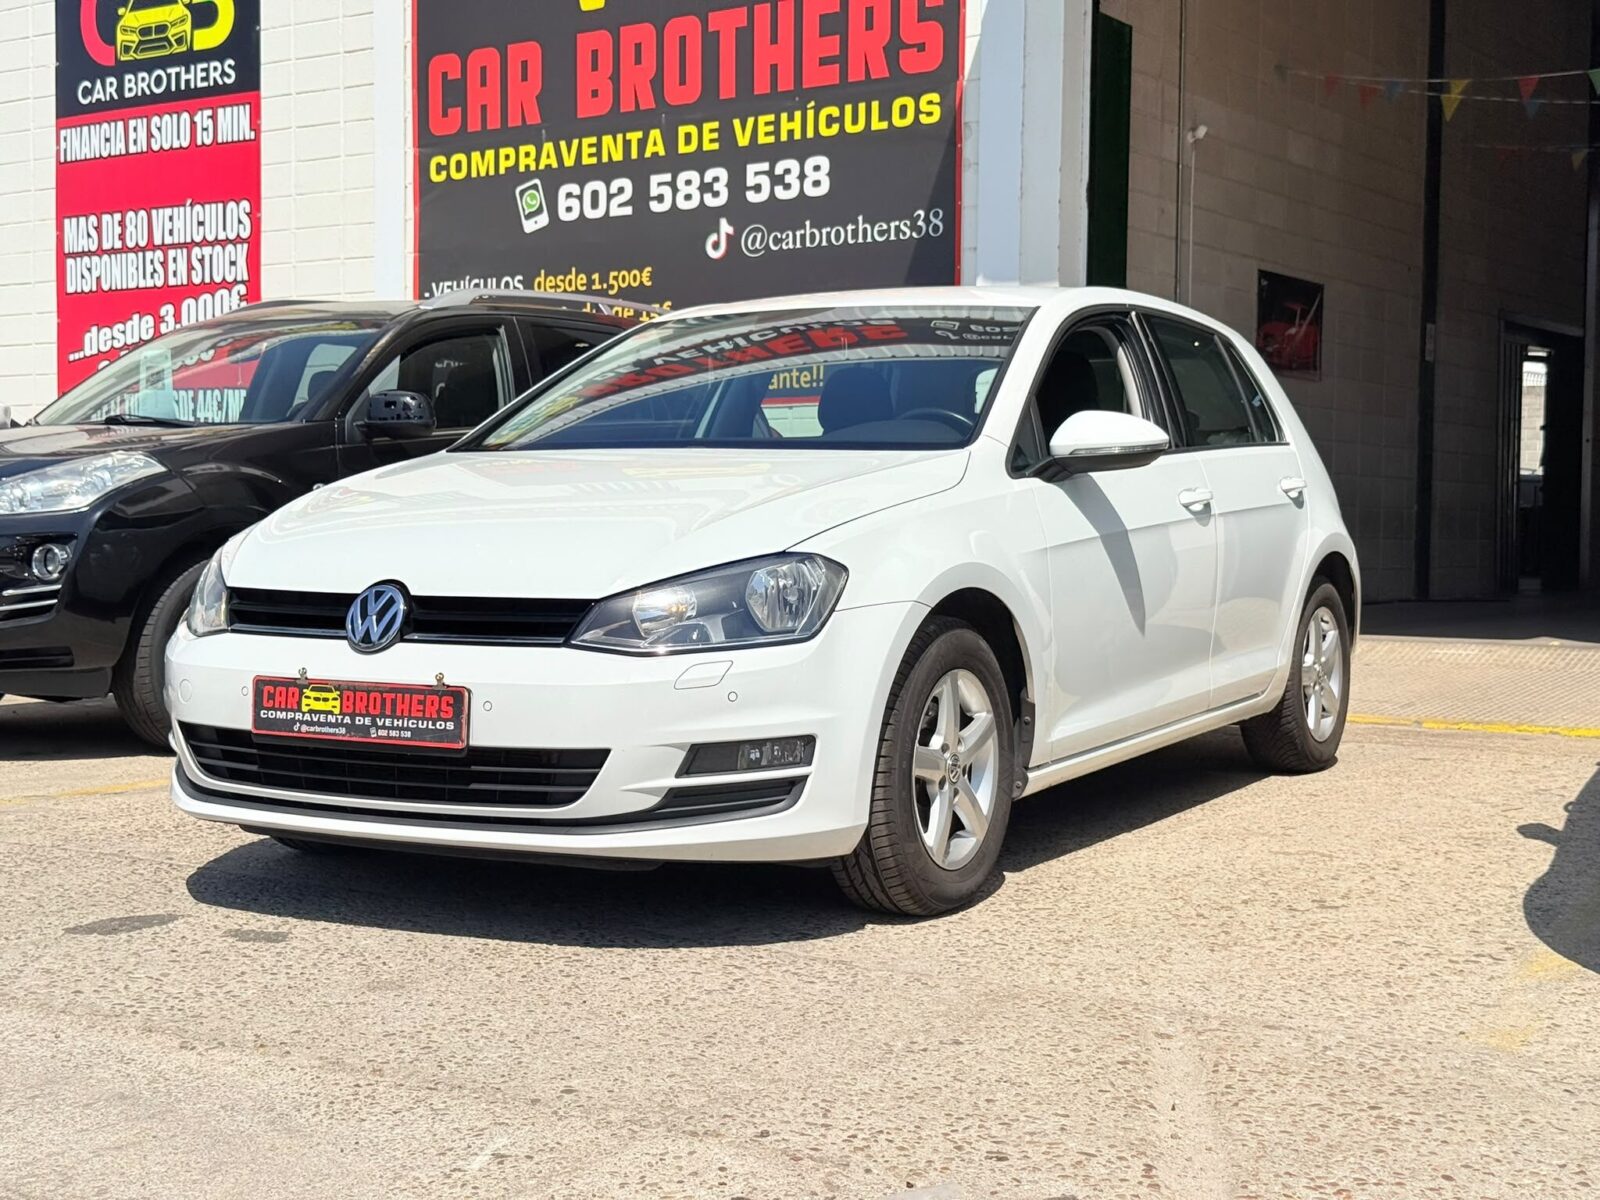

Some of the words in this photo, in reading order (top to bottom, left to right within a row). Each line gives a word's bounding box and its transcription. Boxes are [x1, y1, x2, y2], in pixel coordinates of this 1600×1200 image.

[77, 77, 119, 105] CAR
[124, 59, 236, 99] BROTHERS
[428, 40, 543, 136] CAR
[576, 0, 944, 119] BROTHERS
[59, 120, 126, 163] FINANCIA
[128, 117, 148, 154] EN
[150, 111, 191, 151] SOLO
[193, 109, 214, 146] 15
[217, 104, 255, 143] MIN.
[429, 128, 666, 183] COMPRAVENTA
[677, 121, 720, 154] DE
[732, 92, 941, 147] VEHÍCULOS
[557, 177, 633, 222] 602
[648, 167, 729, 213] 583
[745, 155, 831, 204] 538
[63, 214, 99, 255] MAS
[102, 212, 123, 250] DE
[125, 209, 149, 249] 80
[151, 199, 251, 246] VEHÍCULOS
[740, 208, 944, 258] @carbrothers38
[65, 255, 164, 294] DISPONIBLES
[168, 247, 188, 286] EN
[190, 243, 249, 285] STOCK
[533, 270, 588, 293] desde
[591, 266, 653, 296] 1.500€
[260, 709, 352, 725] COMPRAVENTA
[355, 717, 373, 727] DE
[376, 716, 456, 731] VEHÍCULOS
[262, 685, 300, 710] CAR
[342, 690, 454, 719] BROTHERS
